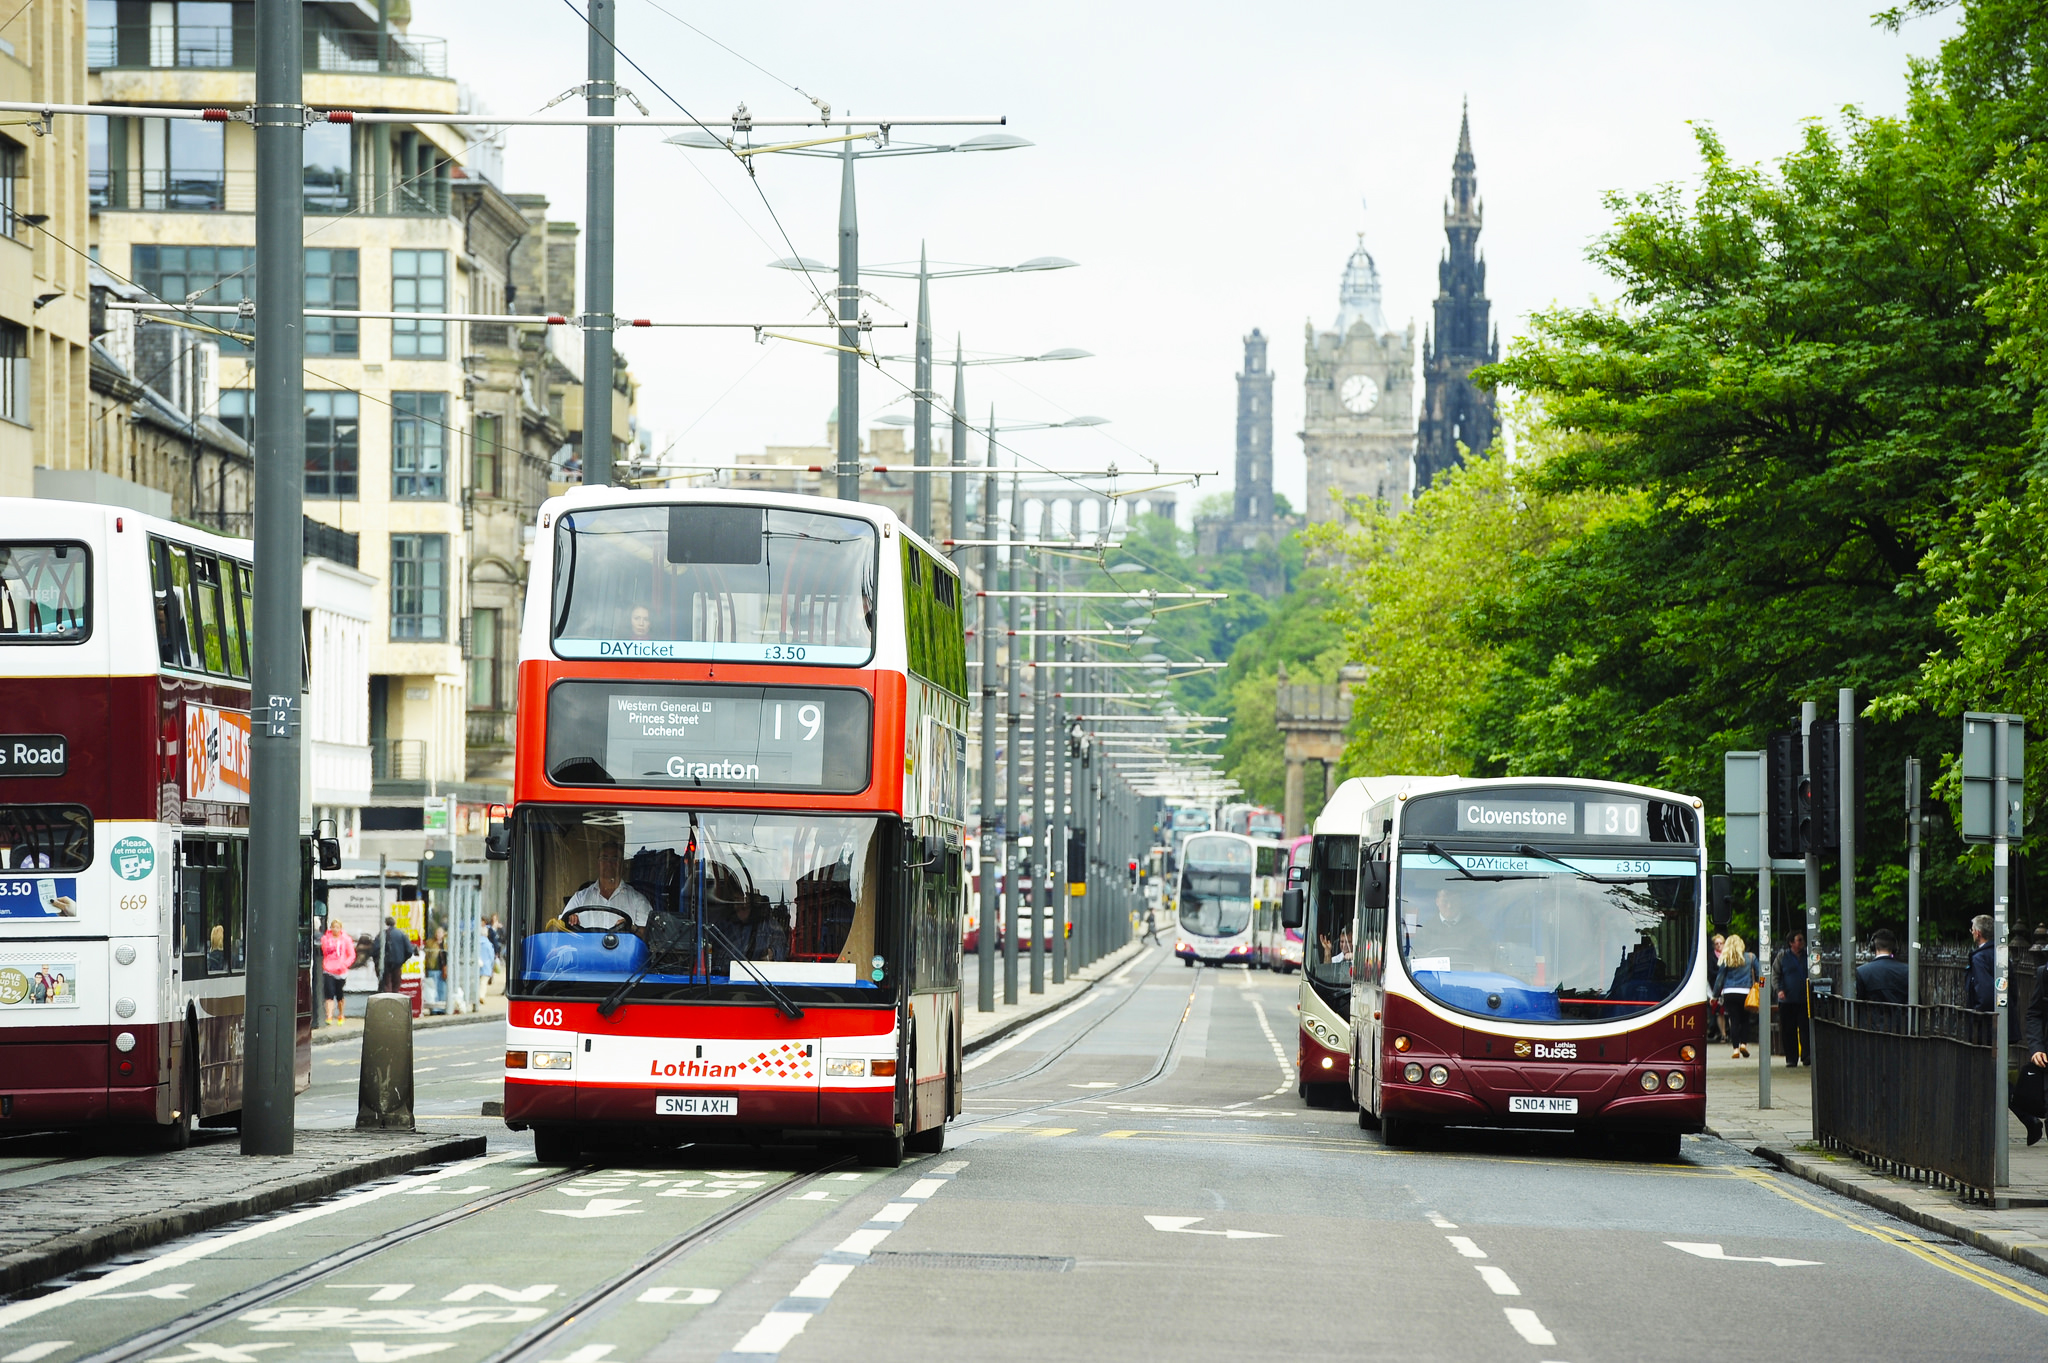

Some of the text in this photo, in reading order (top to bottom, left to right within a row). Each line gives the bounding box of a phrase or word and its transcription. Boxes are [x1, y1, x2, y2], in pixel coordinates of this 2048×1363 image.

[600, 642, 806, 660] DAYticket £3.50
[269, 696, 292, 707] CTY
[617, 700, 657, 711] Western
[660, 700, 700, 712] General
[274, 711, 286, 721] 12
[629, 713, 699, 725] Princes Street
[774, 703, 821, 741] 19
[272, 724, 285, 735] 14
[643, 725, 685, 736] Lochend
[14, 743, 64, 764] Road
[220, 717, 240, 776] NEXT
[666, 756, 759, 780] Granton
[1467, 805, 1638, 833] Clovenstone 30
[121, 839, 147, 847] Please
[1466, 857, 1651, 873] DAYticket £3.50
[120, 894, 147, 910] 669
[1, 971, 21, 981] SAVE
[11, 979, 20, 987] to
[533, 1008, 563, 1026] 603
[1673, 1014, 1695, 1030] 114
[1534, 1043, 1577, 1059] Buses
[650, 1059, 737, 1077] Lothian
[665, 1098, 729, 1112] SN51 AXH
[1515, 1098, 1572, 1111] SN04 NHE
